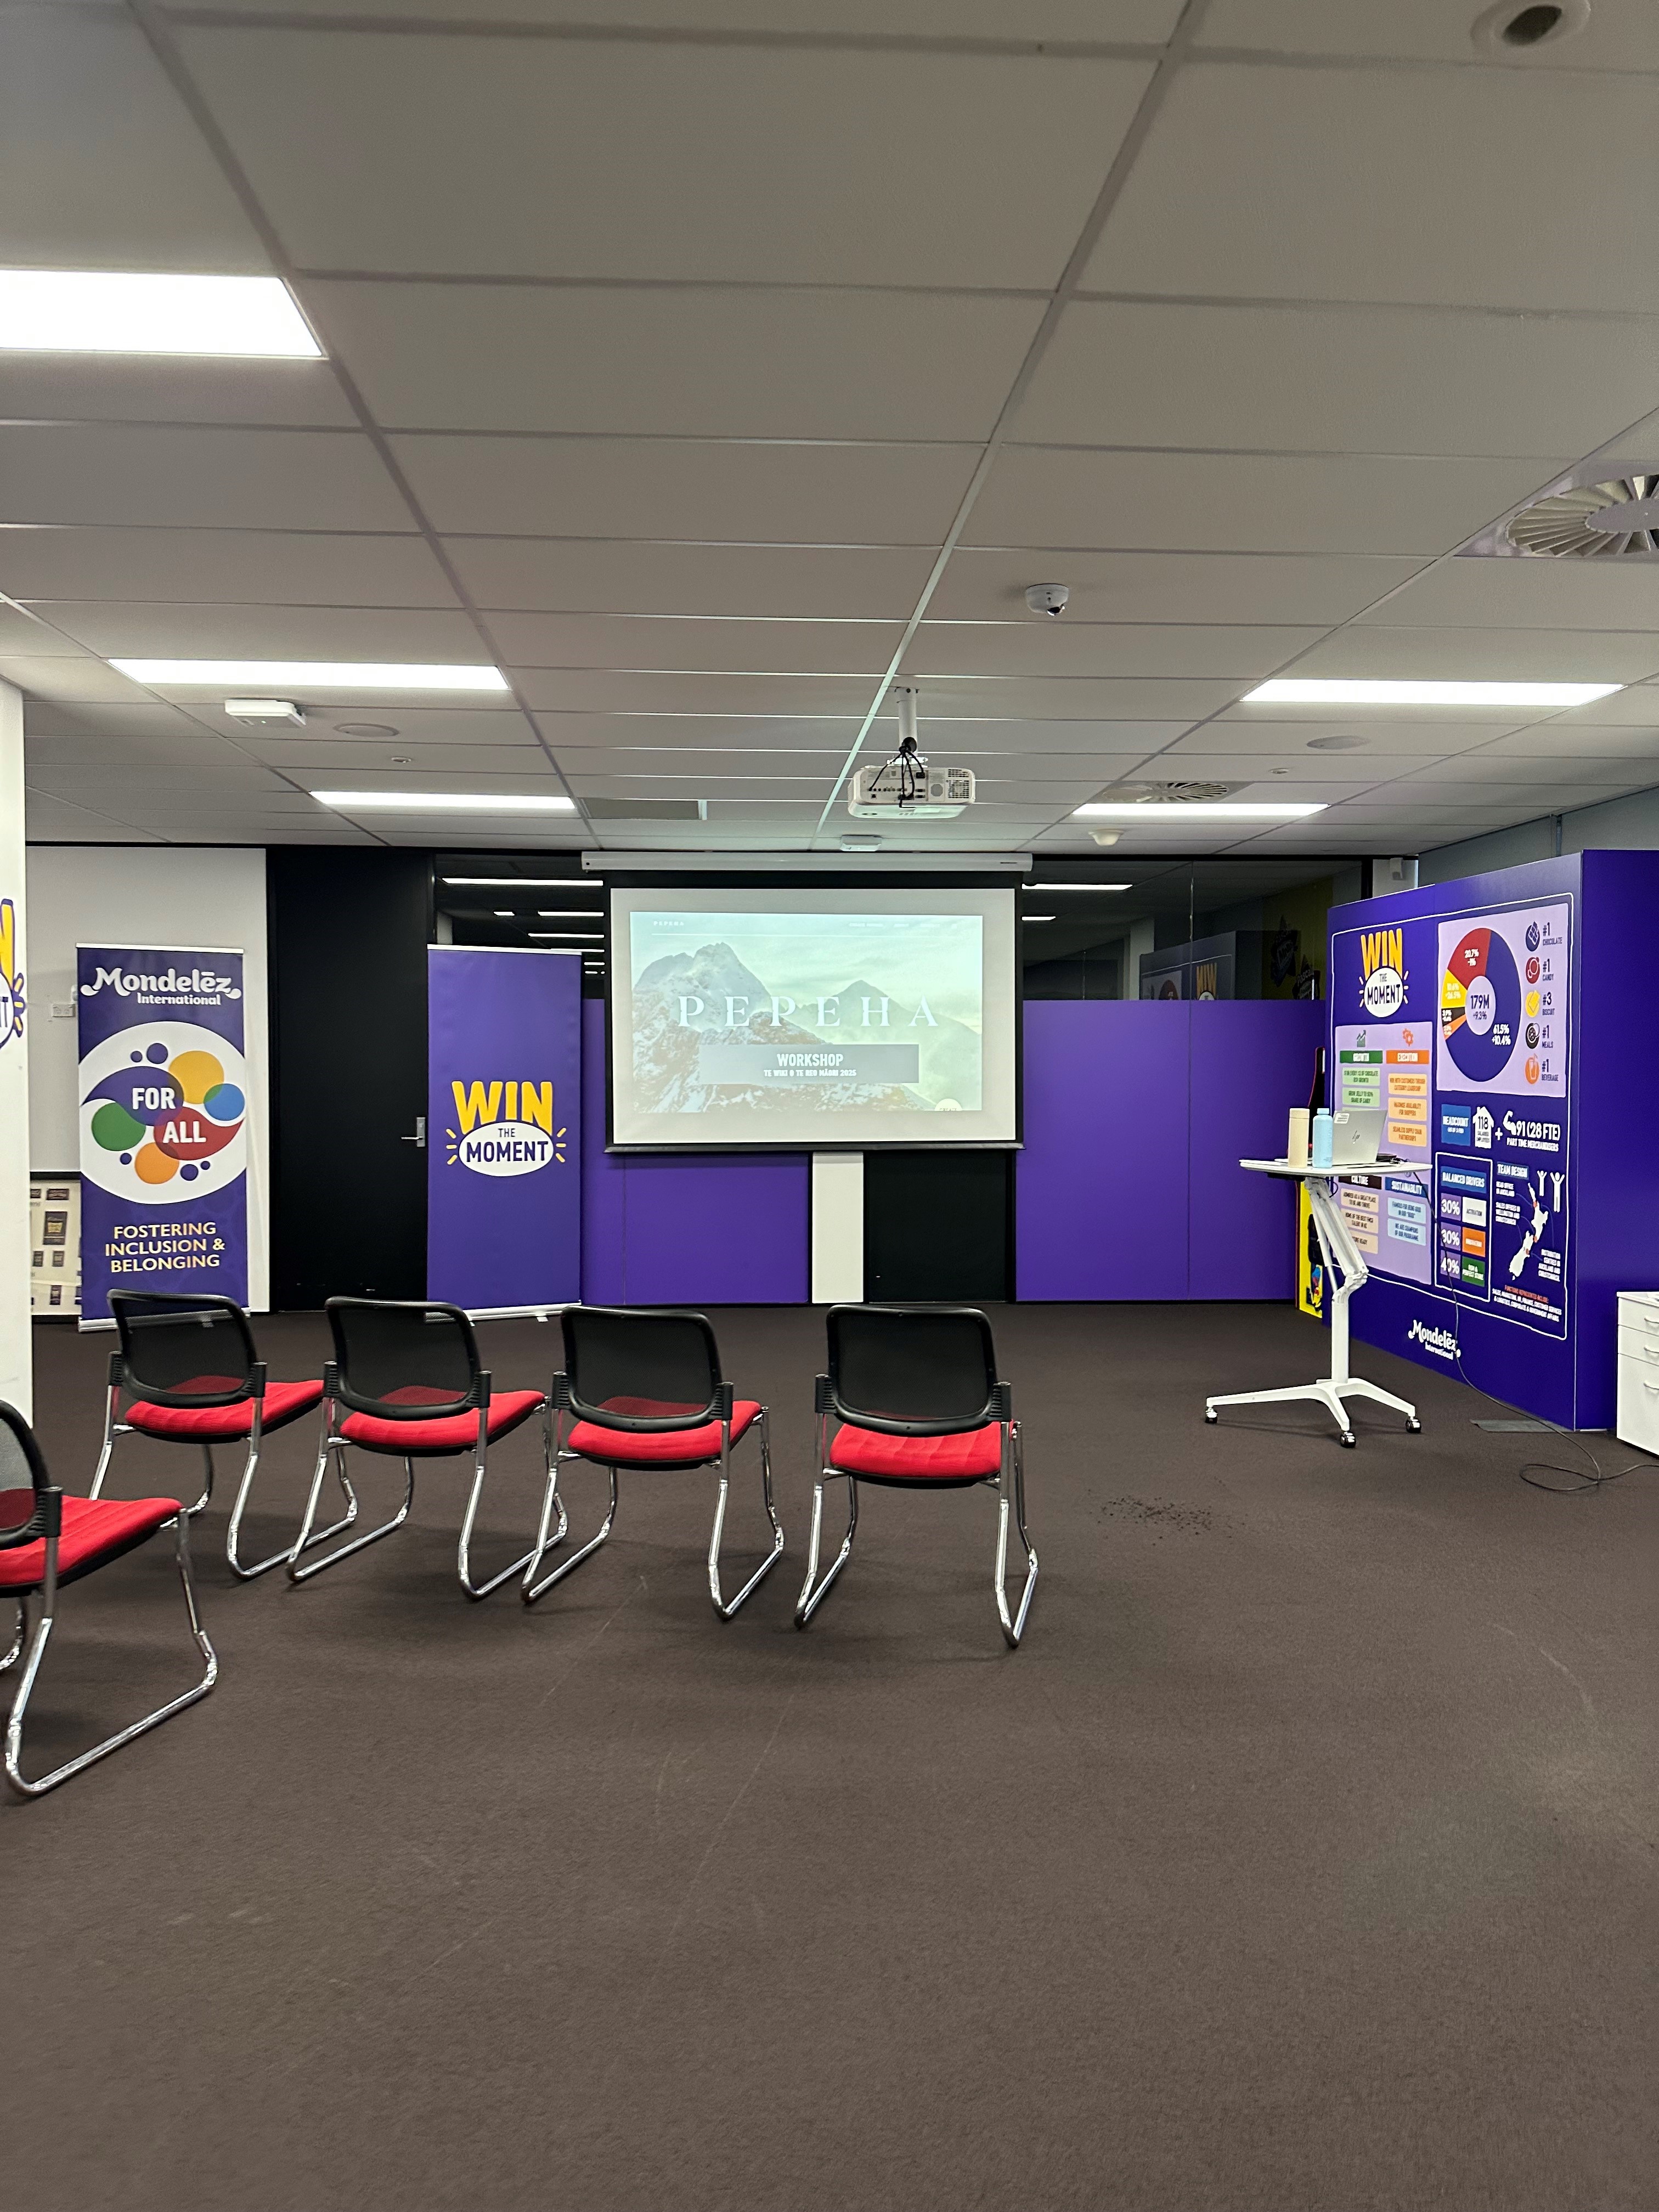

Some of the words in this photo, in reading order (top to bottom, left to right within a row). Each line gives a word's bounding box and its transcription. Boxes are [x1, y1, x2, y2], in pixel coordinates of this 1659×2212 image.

[1542, 922, 1550, 936] #1
[1542, 937, 1562, 946] CHOCOLATE
[1361, 928, 1403, 981] WIN
[1542, 958, 1550, 973] #1
[1379, 973, 1387, 983] THE
[137, 992, 221, 1006] International
[1367, 984, 1401, 1006] MOMENT
[1470, 994, 1489, 1010] 179M
[1542, 991, 1552, 1006] #3
[678, 996, 939, 1028] PEPEHA
[1542, 1025, 1550, 1039] #1
[777, 1053, 843, 1066] WORKSHOP
[1541, 1059, 1549, 1073] #1
[132, 1088, 176, 1109] FOR
[452, 1081, 553, 1136] WIN
[1478, 1116, 1488, 1130] 118
[1516, 1121, 1526, 1137] 91
[1527, 1121, 1542, 1139] (28
[1543, 1124, 1561, 1141] FTE)
[162, 1121, 206, 1143] ALL
[498, 1127, 516, 1138] THE
[466, 1141, 549, 1163] MOMENT
[1497, 1164, 1511, 1175] TEAM
[1441, 1199, 1460, 1215] 30%
[114, 1222, 216, 1239] FOSTERING
[1441, 1229, 1460, 1246] 30%
[105, 1239, 207, 1257] INCLUSION
[212, 1238, 225, 1251] &
[110, 1254, 220, 1273] BELONGING
[1440, 1256, 1460, 1274] 40%
[1425, 1342, 1453, 1360] International
